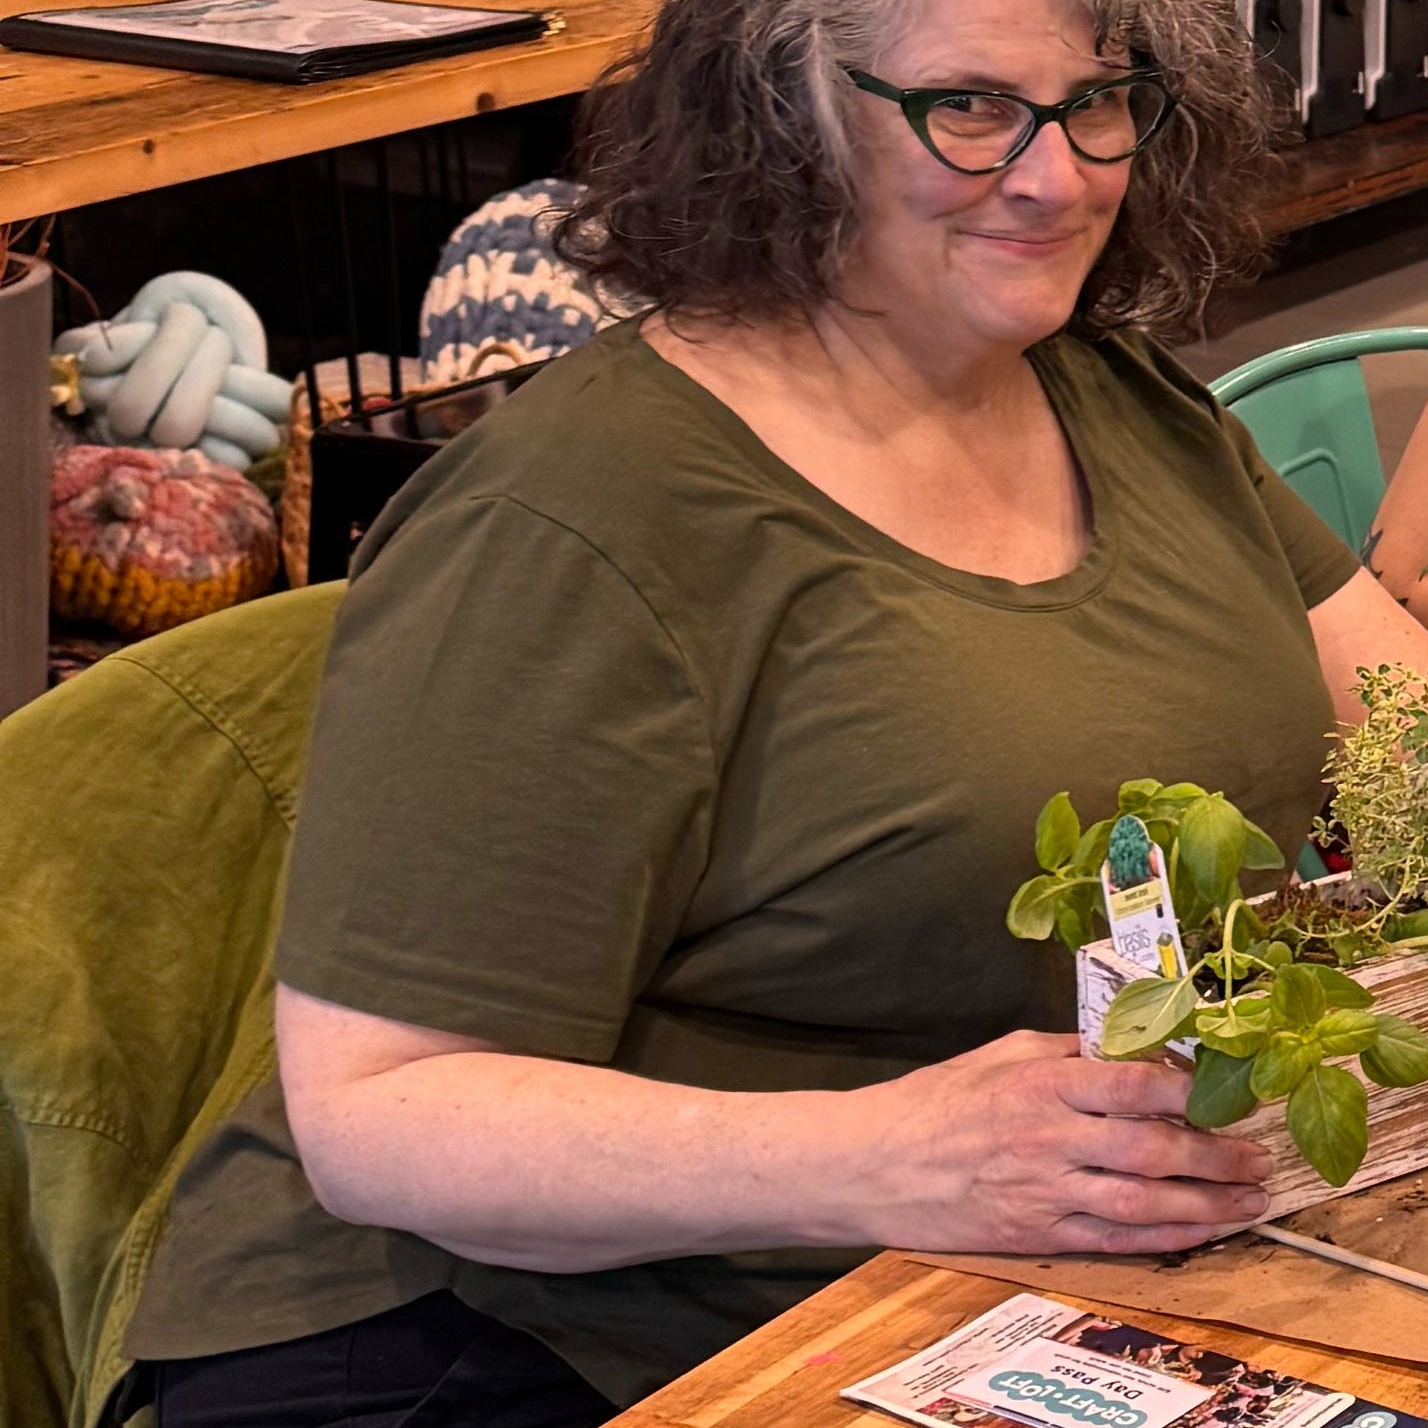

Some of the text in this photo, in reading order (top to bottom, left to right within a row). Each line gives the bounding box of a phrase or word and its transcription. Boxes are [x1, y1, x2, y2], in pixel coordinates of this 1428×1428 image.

[1050, 1365, 1100, 1385] Pass
[998, 1375, 1139, 1425] CRAFT LOFT
[1101, 1379, 1144, 1400] Day
